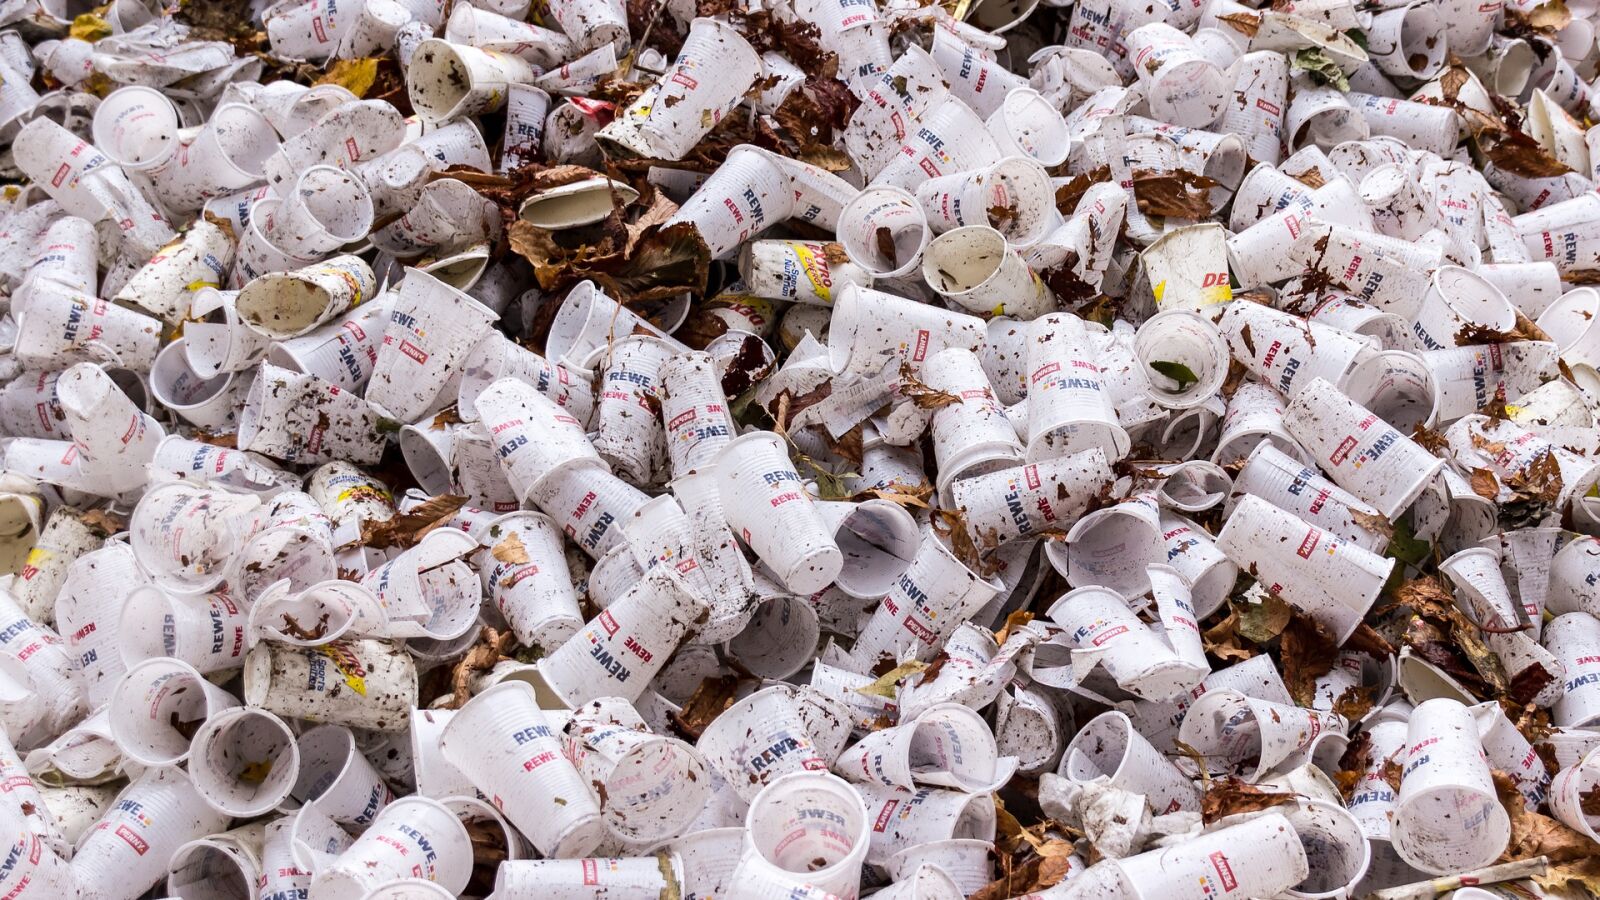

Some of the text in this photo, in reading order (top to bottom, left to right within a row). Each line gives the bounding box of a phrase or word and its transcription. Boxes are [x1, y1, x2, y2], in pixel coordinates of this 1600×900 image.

[842, 14, 866, 26] REWE
[1080, 6, 1109, 26] REWE
[960, 48, 973, 79] REWE
[976, 69, 988, 93] REWE
[919, 128, 944, 149] REWE
[724, 198, 743, 224] REWE
[744, 185, 764, 226] REWE
[1542, 231, 1553, 258] REWE
[1344, 254, 1363, 280] REWE
[338, 338, 363, 384] REWE
[1072, 360, 1098, 372] REWE
[1262, 340, 1282, 369] REWE
[610, 370, 650, 390] REWE
[1057, 376, 1101, 390] REWE
[1282, 357, 1301, 395] REWE
[1473, 366, 1487, 410] REWE
[492, 418, 523, 434] REWE
[1371, 429, 1400, 462] REWE
[572, 490, 597, 521] REWE
[1004, 489, 1032, 534] REWE
[1309, 486, 1332, 515] REWE
[581, 511, 614, 549] REWE
[899, 573, 928, 609] REWE
[212, 608, 224, 654] REWE
[231, 625, 244, 657] REWE
[589, 641, 632, 684] REWE
[623, 635, 654, 664] REWE
[522, 750, 558, 773] REWE
[354, 786, 380, 826] REWE
[376, 834, 409, 857] REWE
[398, 823, 438, 864] REWE
